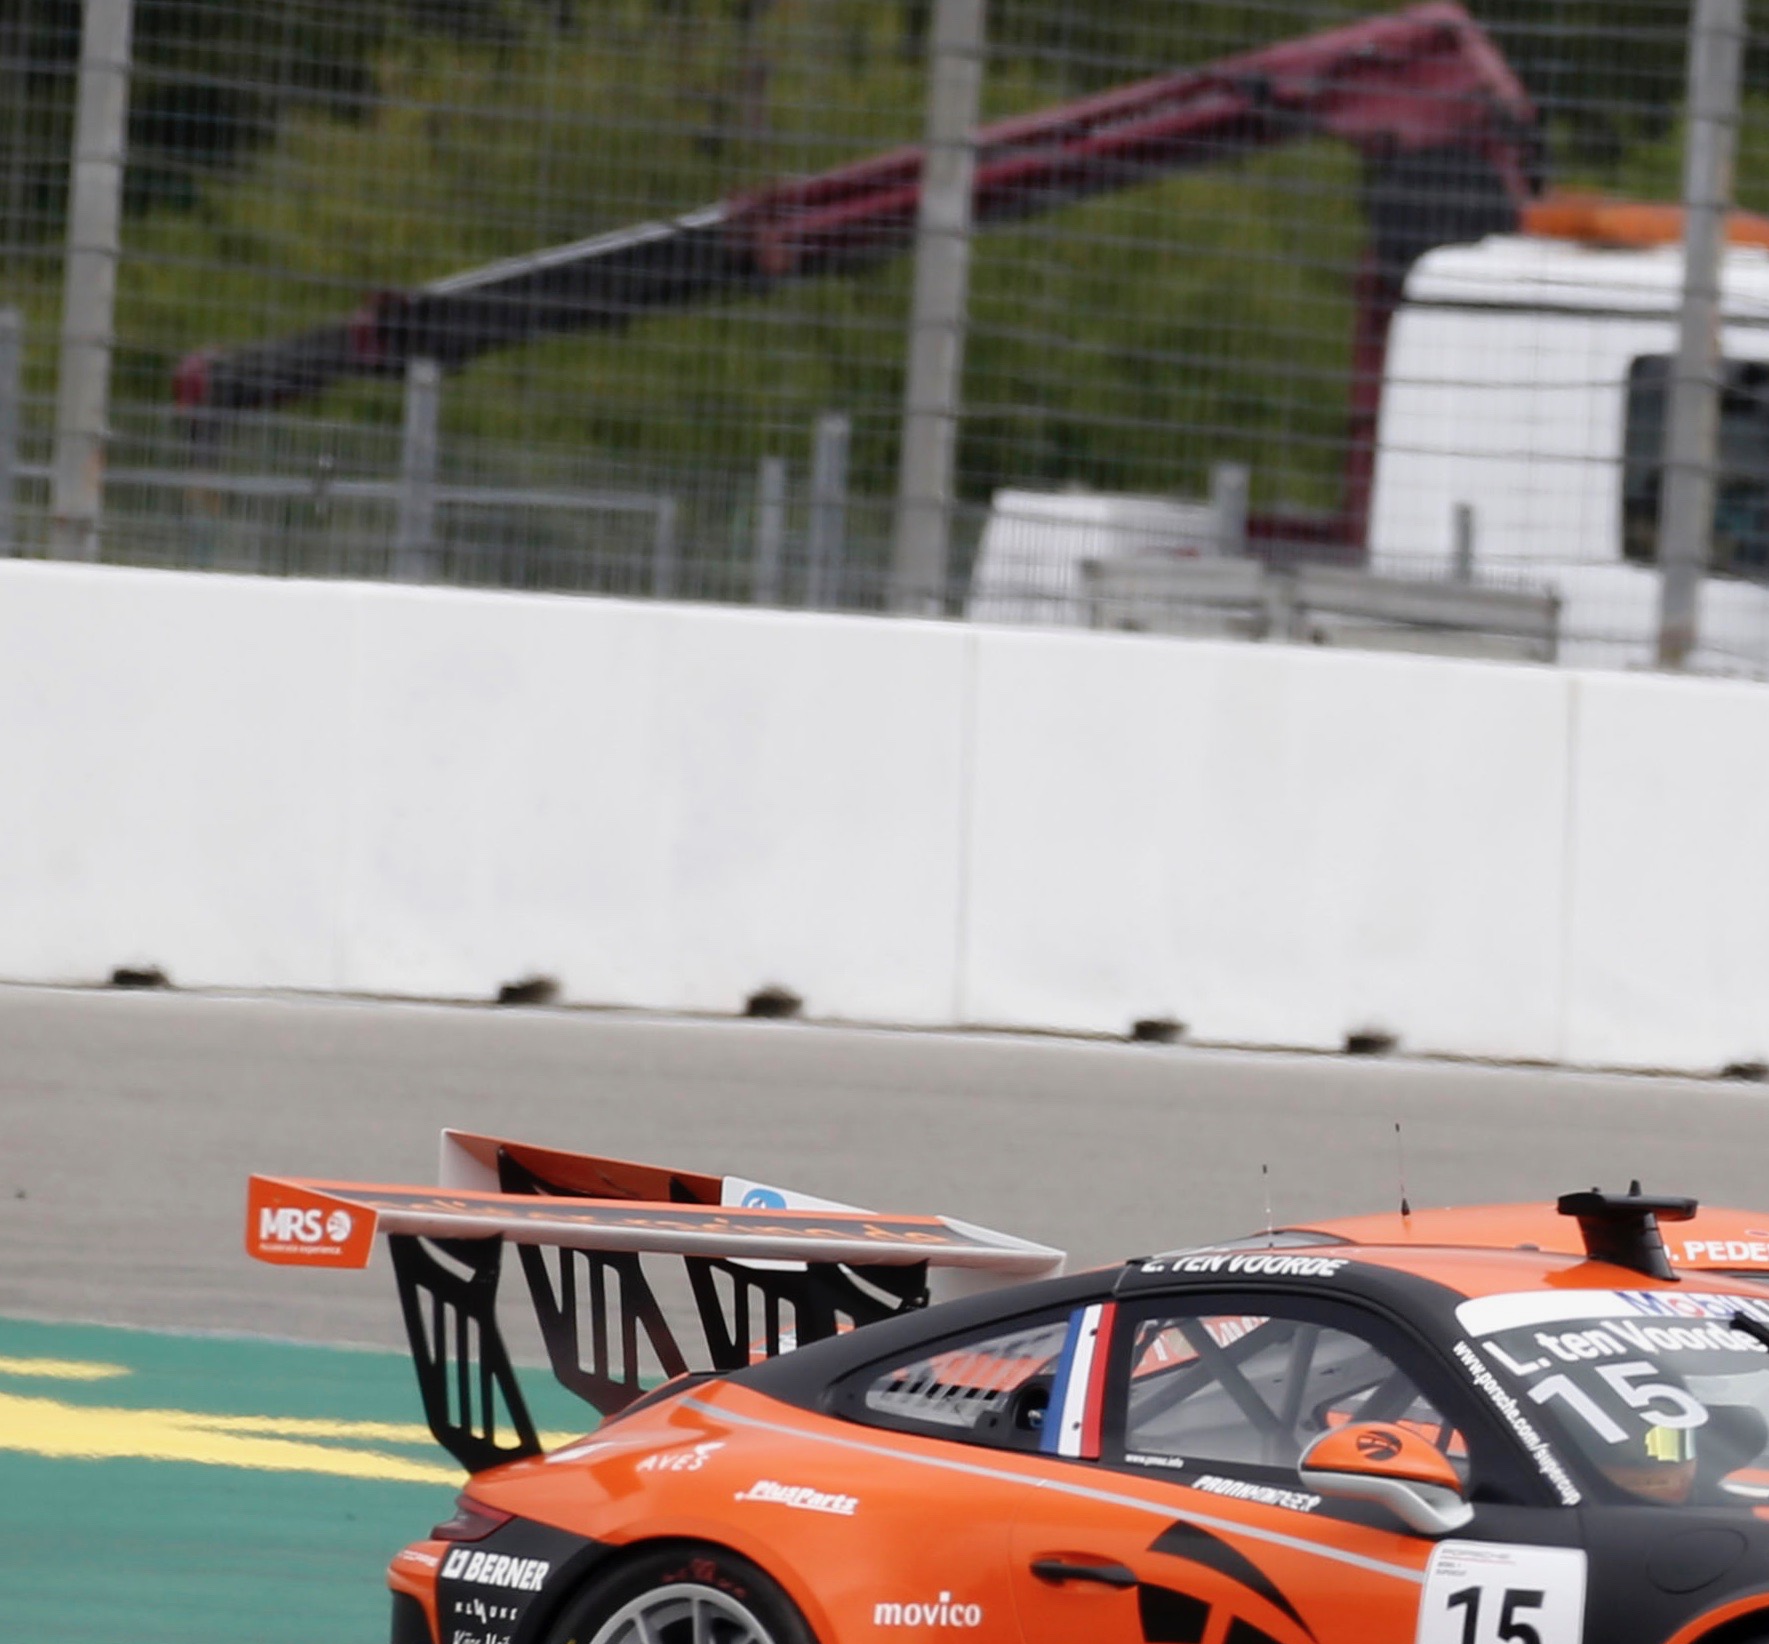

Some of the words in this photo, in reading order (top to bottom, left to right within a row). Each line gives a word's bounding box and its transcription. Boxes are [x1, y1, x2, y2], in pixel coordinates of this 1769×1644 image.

[260, 1207, 323, 1242] MRS
[1172, 1255, 1228, 1273] TEN
[1227, 1256, 1349, 1277] VOORDE
[1482, 1340, 1552, 1377] L.
[1533, 1327, 1628, 1362] ten
[1600, 1319, 1769, 1354] Voorde
[1526, 1360, 1710, 1445] 15
[1453, 1340, 1582, 1506] www.porsche.com/supercup
[634, 1453, 711, 1473] AVES
[748, 1479, 859, 1513] PlusParts
[463, 1550, 550, 1592] BERNER
[872, 1590, 983, 1628] movico
